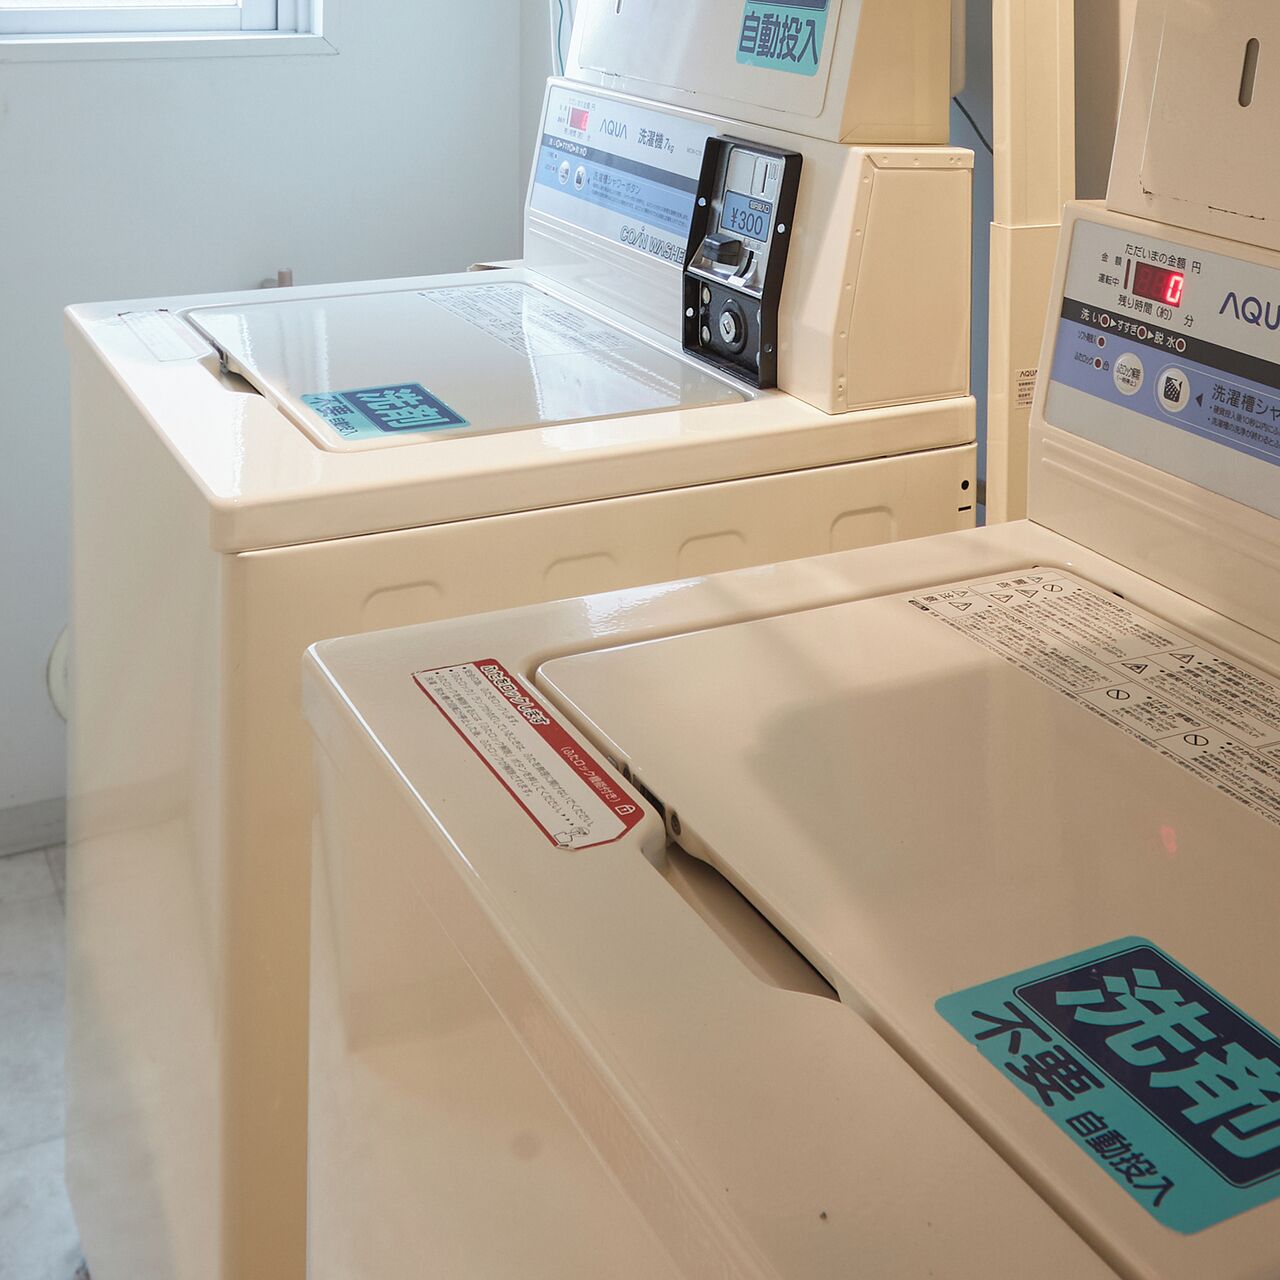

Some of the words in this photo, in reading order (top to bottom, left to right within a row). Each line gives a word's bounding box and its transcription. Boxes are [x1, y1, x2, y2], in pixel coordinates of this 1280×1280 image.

[738, 9, 820, 66] 自動投入
[599, 118, 628, 140] AQUA
[637, 127, 663, 151] 洗濯機
[730, 206, 764, 236] ¥300
[648, 235, 687, 265] WASHE
[1124, 243, 1187, 272] ただいまの金額
[1191, 260, 1202, 275] 円
[1097, 272, 1121, 288] 運転中
[1166, 274, 1185, 304] 0
[1079, 307, 1100, 323] 洗い
[1117, 319, 1138, 336] すすぎ
[1153, 331, 1177, 349] 脱水
[1184, 314, 1195, 329] 分
[356, 387, 450, 428] 洗剤
[481, 663, 550, 726] ふたをロックします
[970, 1000, 1106, 1108] 不要
[1065, 1110, 1176, 1209] 自動投入
